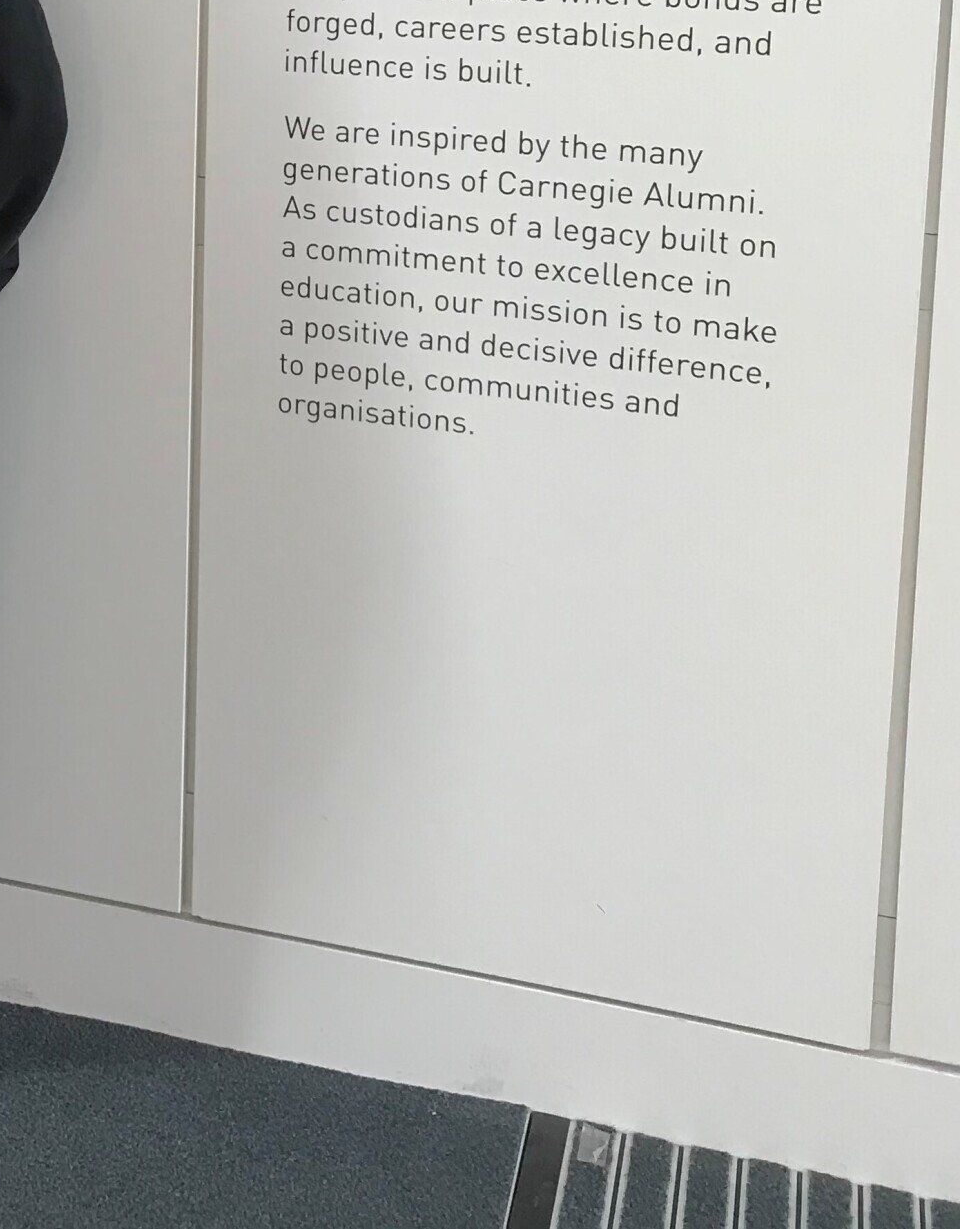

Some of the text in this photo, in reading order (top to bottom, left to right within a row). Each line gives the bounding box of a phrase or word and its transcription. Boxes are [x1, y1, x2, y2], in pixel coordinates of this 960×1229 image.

[286, 8, 772, 57] forged, careers established, and
[285, 48, 531, 88] influence is built.
[284, 115, 704, 175] We are inspired by the many
[283, 161, 764, 215] generations of Carnegie Alumni.
[282, 195, 776, 259] As custodians of a legacy built on
[281, 240, 731, 298] a commitment to excellence in
[280, 275, 777, 344] education, our mission is to make
[279, 318, 771, 390] a positive and decisive difference,
[279, 353, 680, 418] to people, communities and
[278, 396, 474, 436] organisations.
